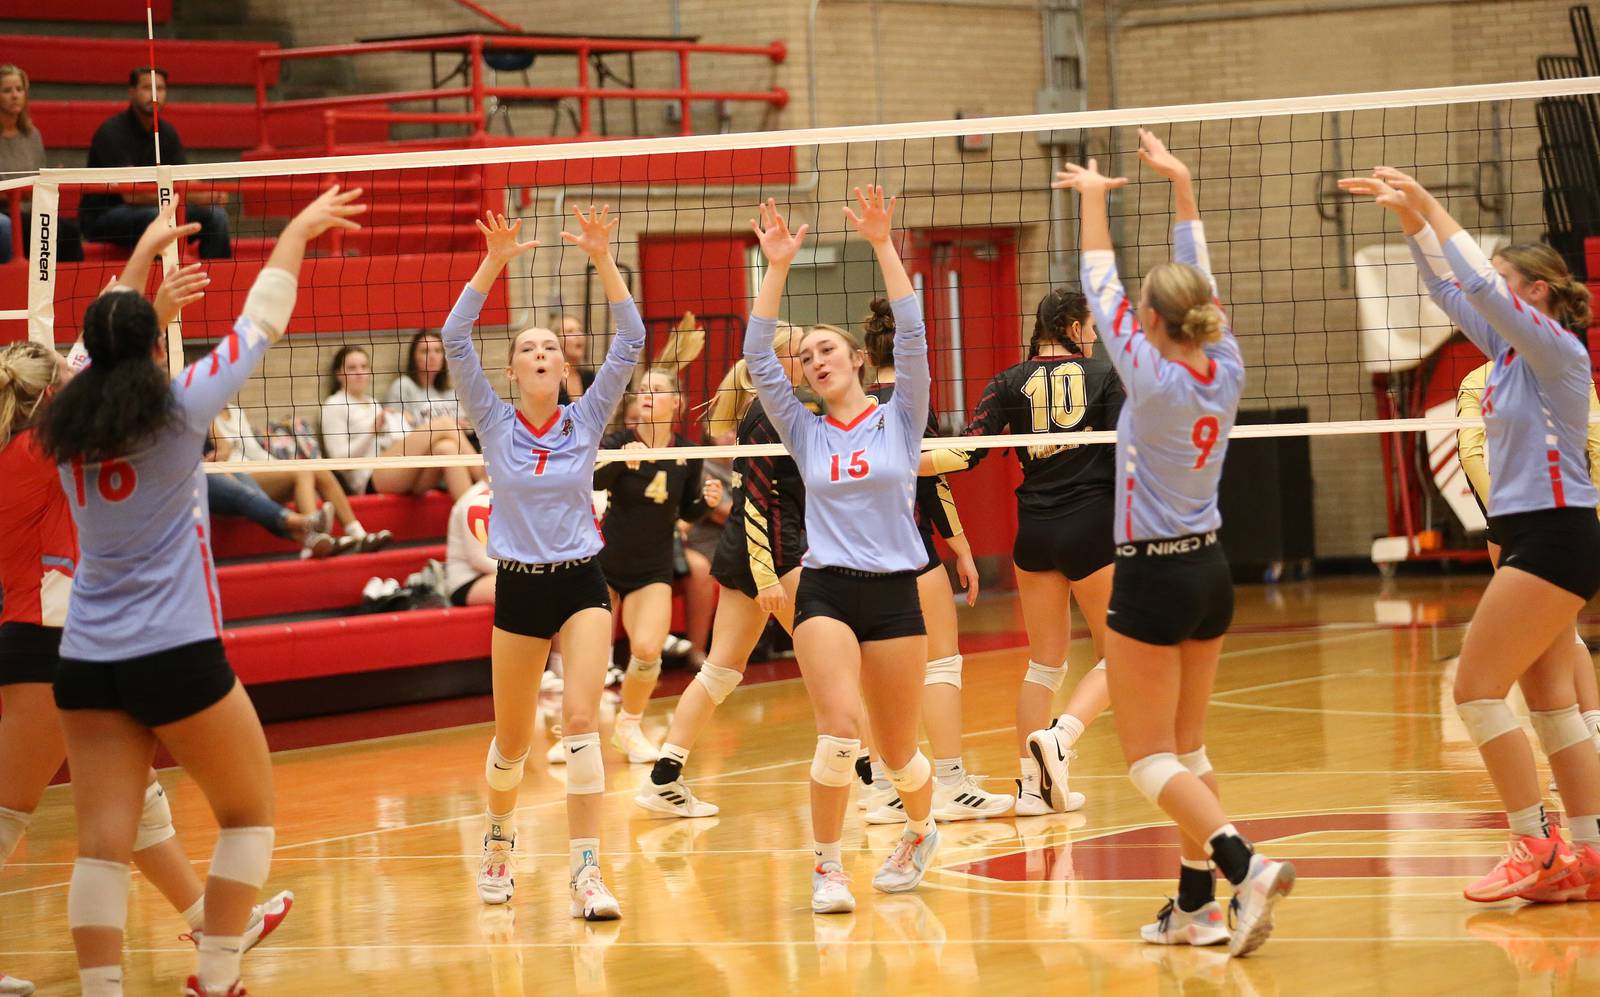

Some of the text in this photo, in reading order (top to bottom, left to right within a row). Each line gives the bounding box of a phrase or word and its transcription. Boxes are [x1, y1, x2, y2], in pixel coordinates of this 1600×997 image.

[1021, 362, 1088, 433] 10
[1191, 416, 1220, 470] 9
[531, 448, 550, 476] 7
[829, 448, 870, 482] 15
[645, 471, 668, 503] 4
